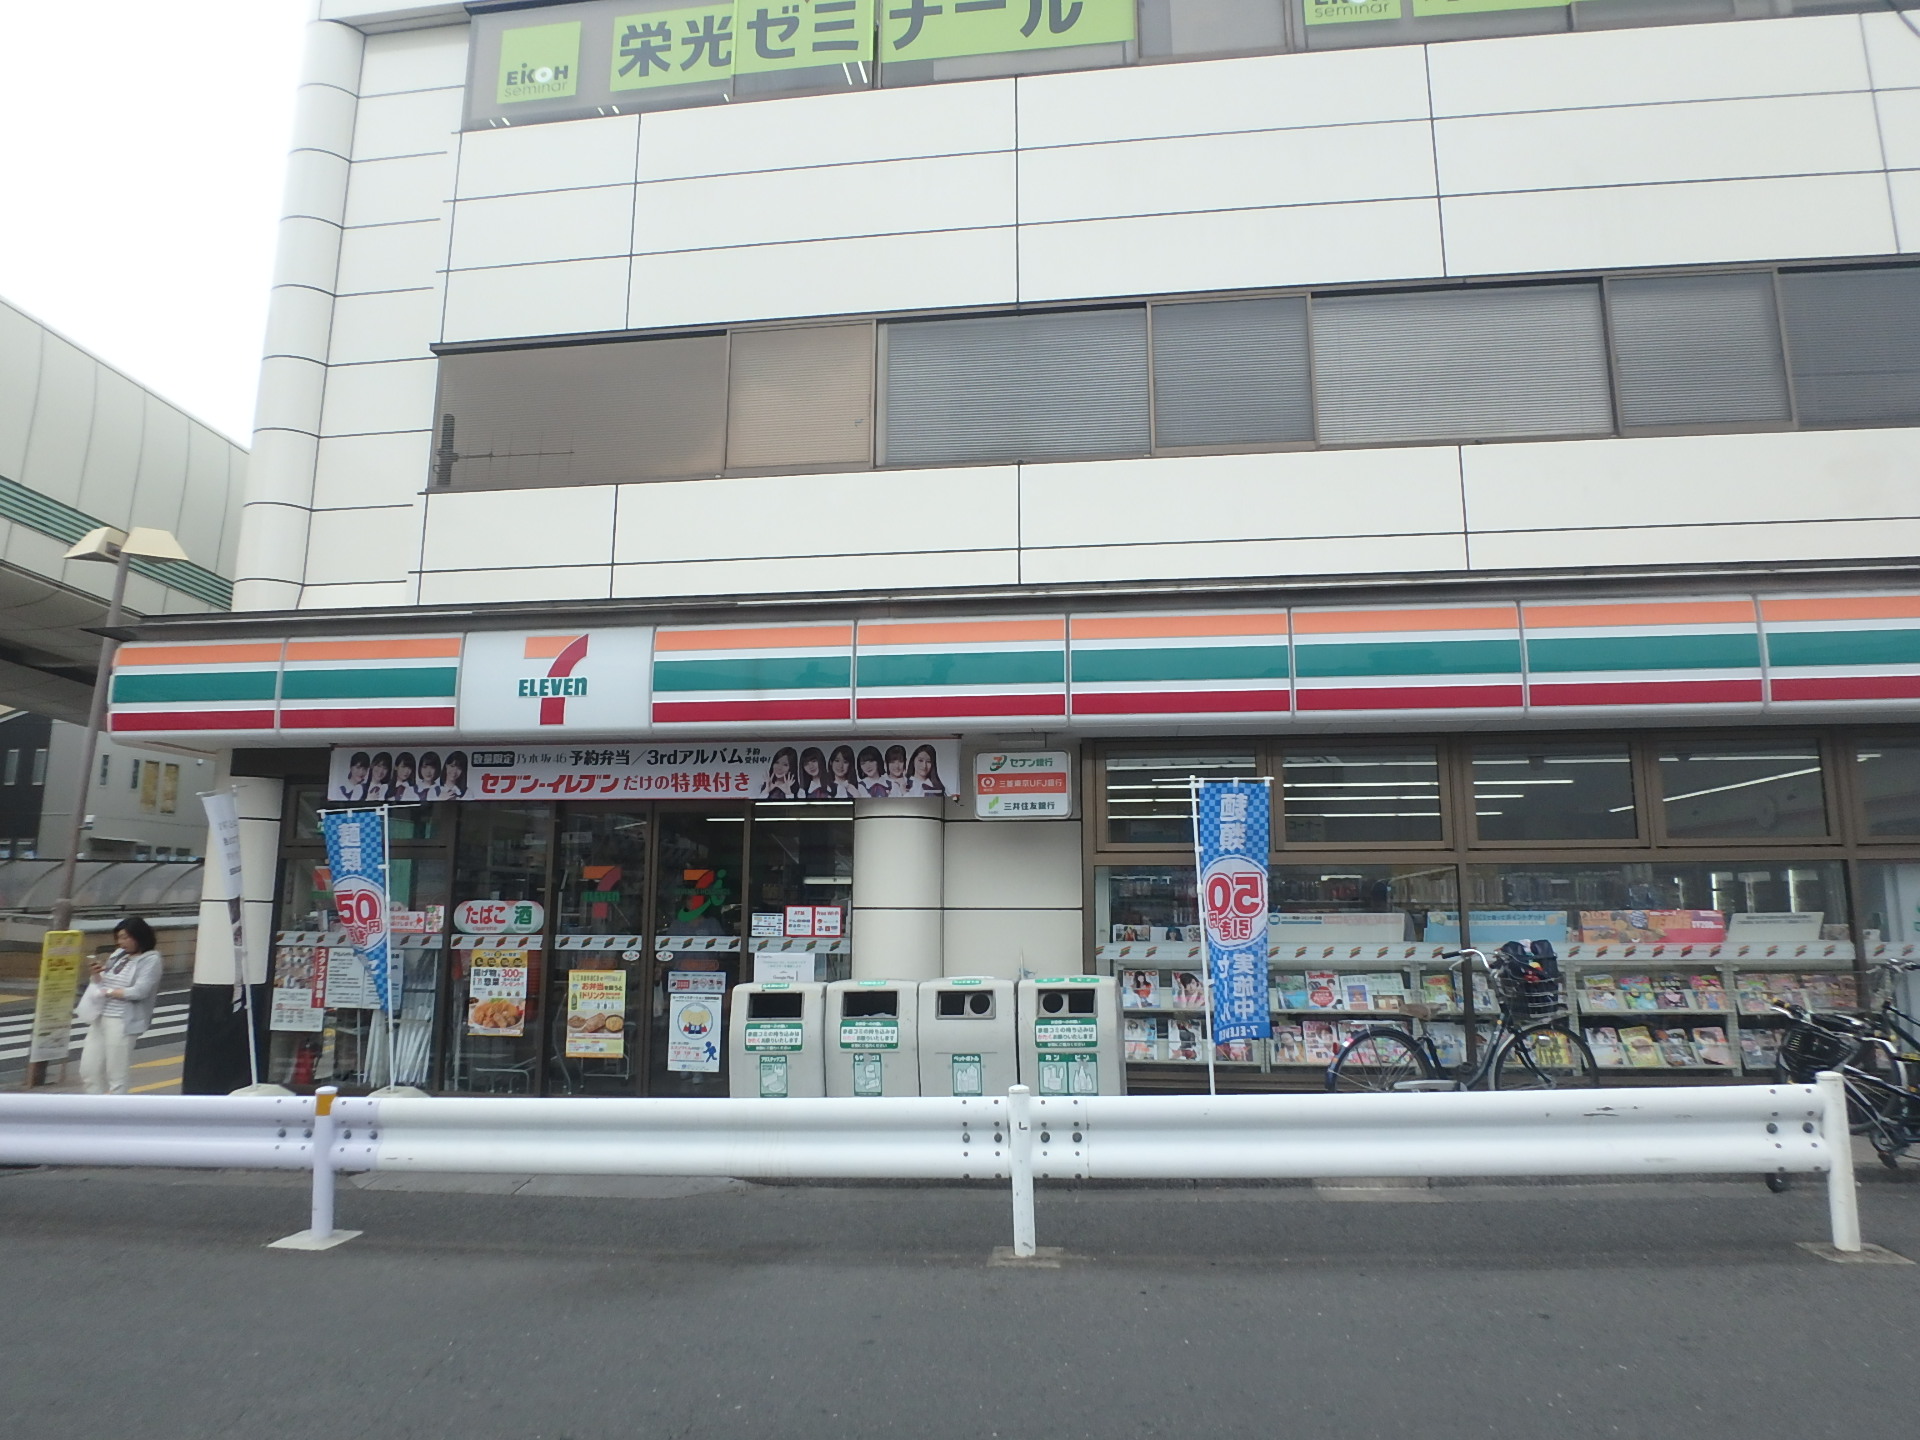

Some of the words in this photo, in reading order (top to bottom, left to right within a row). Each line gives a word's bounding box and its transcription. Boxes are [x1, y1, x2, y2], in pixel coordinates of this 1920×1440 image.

[1314, 2, 1390, 18] seminar
[504, 82, 569, 98] seminar
[1010, 757, 1053, 768] セブン銀行
[623, 771, 750, 793] だけの特典付き
[1004, 801, 1056, 811] 三井住友銀行
[465, 904, 506, 925] たばこ
[514, 905, 533, 925] 酒
